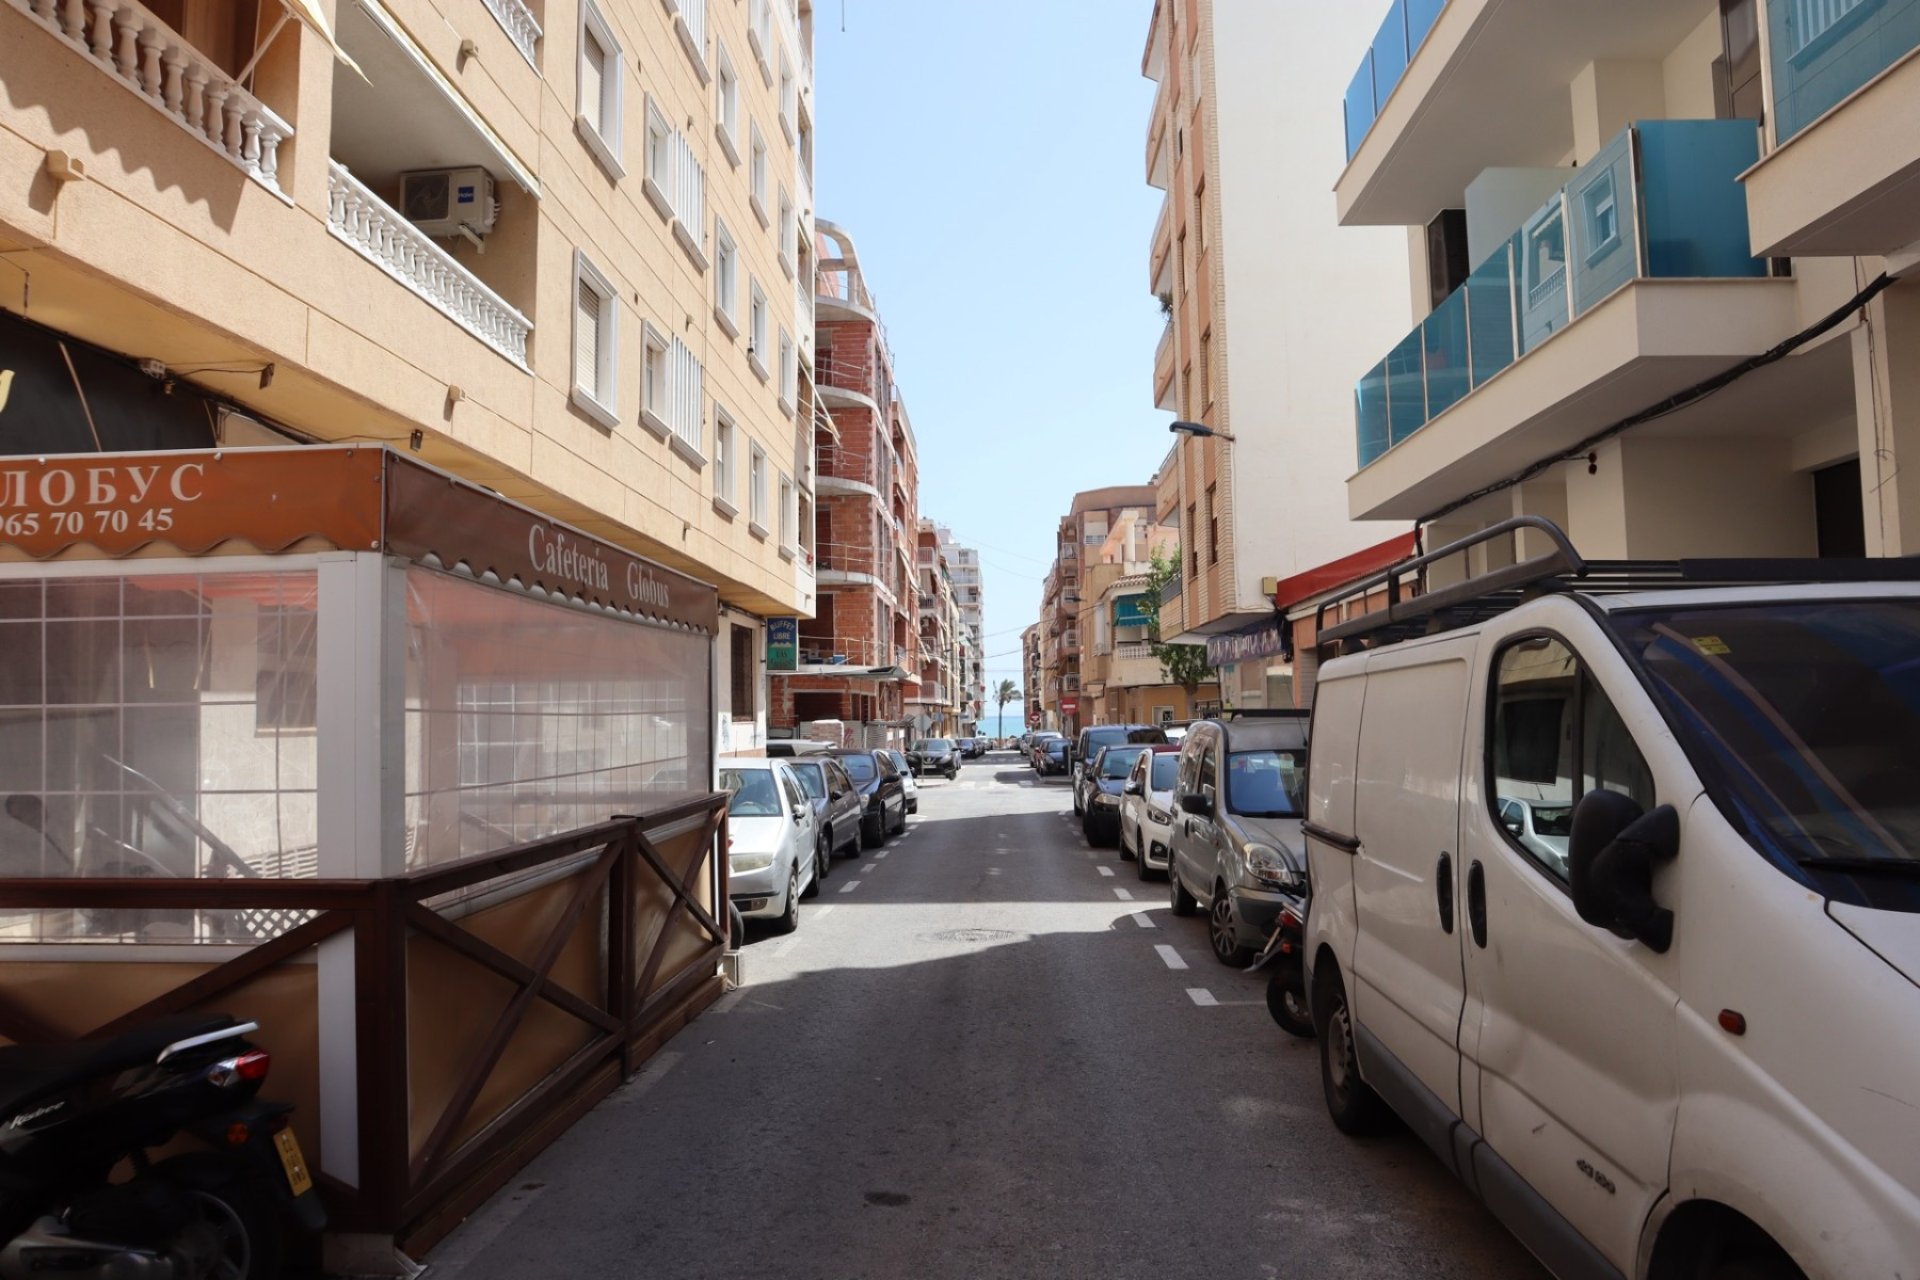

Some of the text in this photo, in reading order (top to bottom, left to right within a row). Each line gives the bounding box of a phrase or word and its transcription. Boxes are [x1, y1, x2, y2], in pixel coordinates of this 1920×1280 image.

[0, 463, 205, 508] ЛОБУС
[0, 508, 174, 536] 65 70 70 45
[626, 561, 670, 609] Globus
